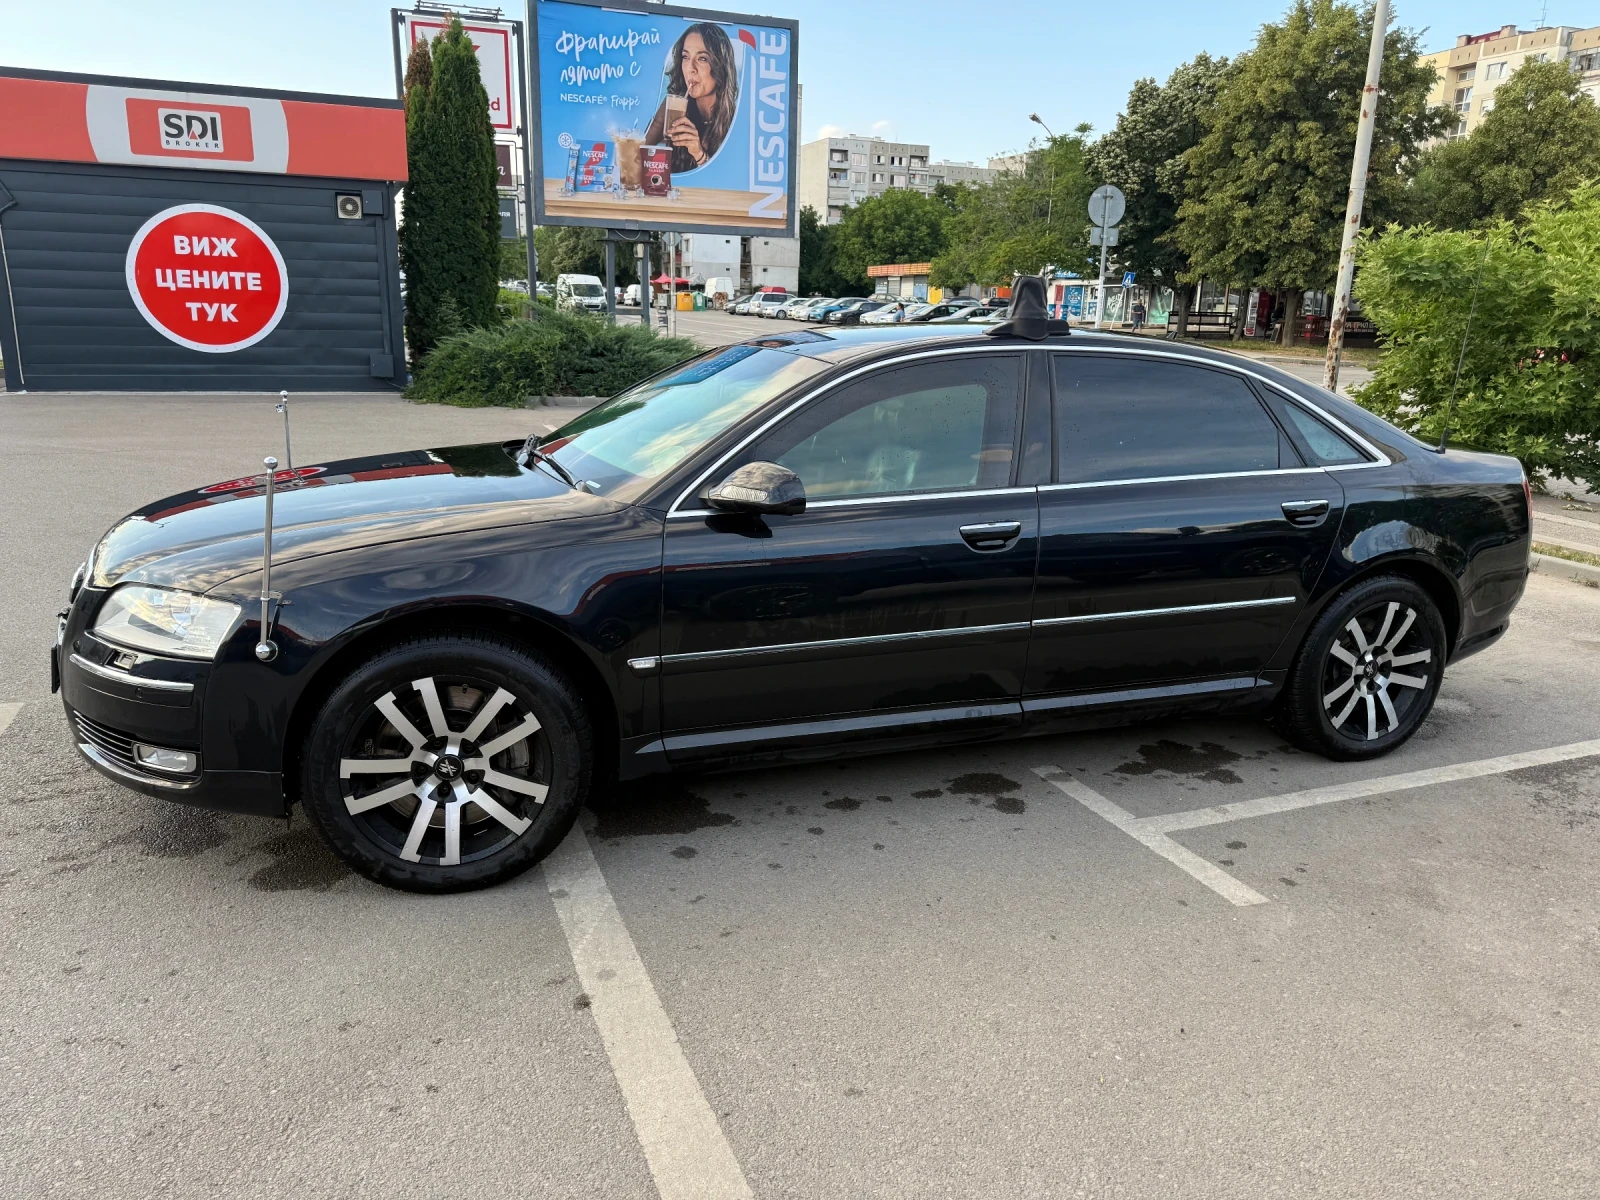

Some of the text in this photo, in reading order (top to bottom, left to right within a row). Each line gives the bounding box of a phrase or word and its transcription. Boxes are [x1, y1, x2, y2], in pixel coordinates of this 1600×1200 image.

[555, 28, 660, 62] Фрапирай
[560, 63, 624, 86] лятото
[163, 113, 219, 141] SDI
[165, 139, 220, 149] BROKER
[173, 234, 239, 258] ВИЖ
[155, 268, 262, 291] ЦЕНИТЕ
[185, 301, 239, 323] ТУК
